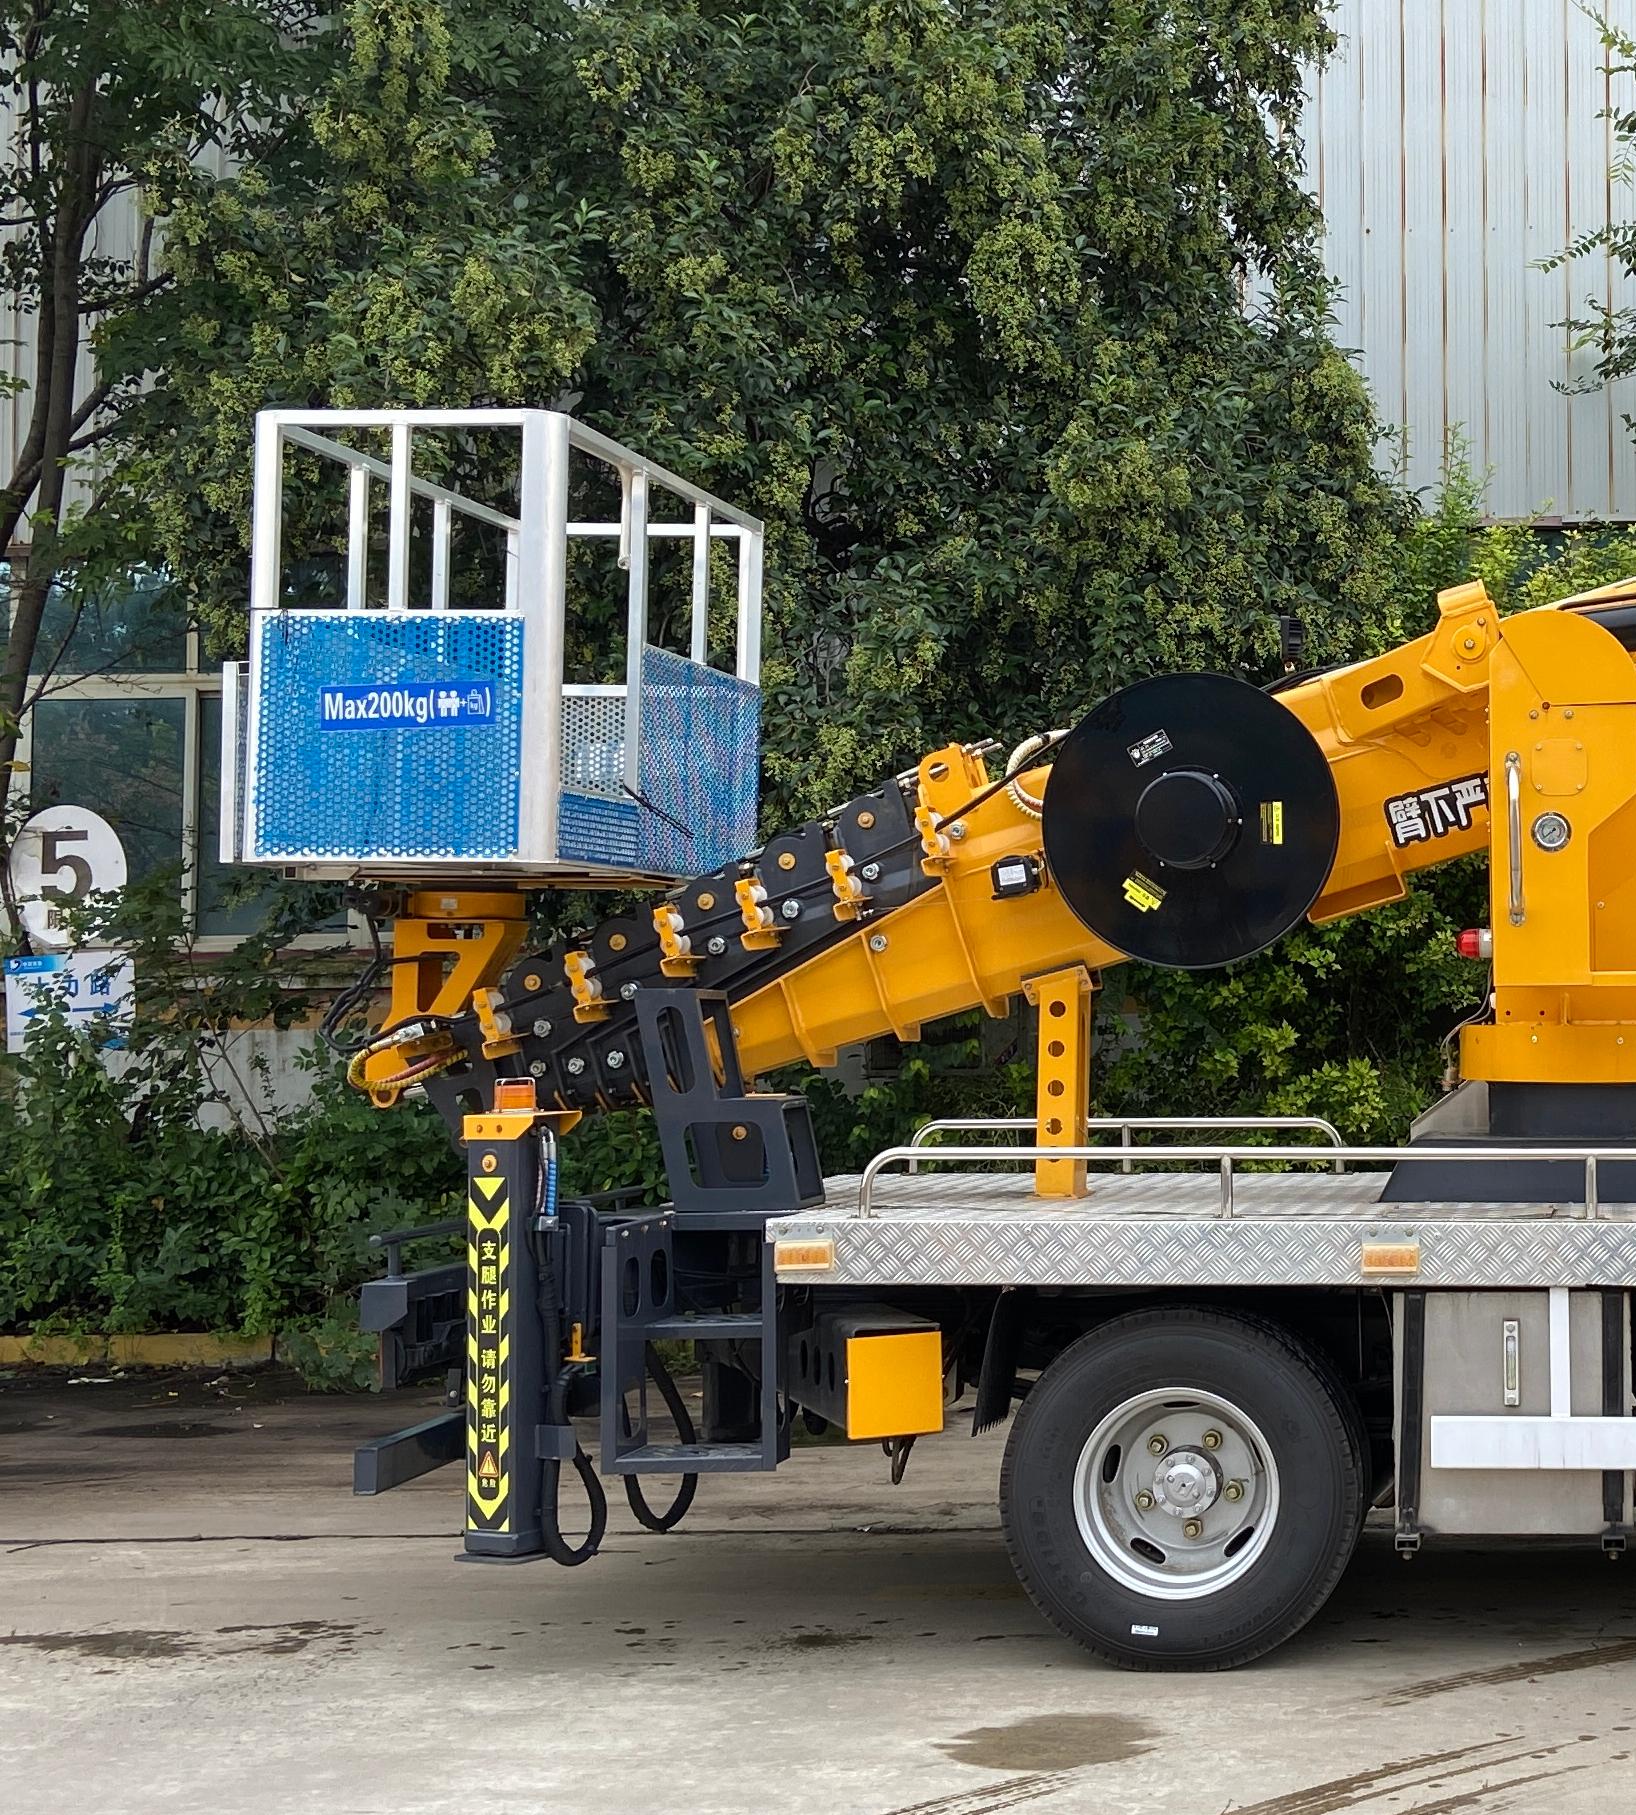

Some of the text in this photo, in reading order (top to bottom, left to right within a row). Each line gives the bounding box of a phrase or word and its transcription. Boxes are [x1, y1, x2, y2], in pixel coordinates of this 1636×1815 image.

[1388, 777, 1489, 845] 臂下严
[41, 830, 94, 901] 5
[480, 1239, 498, 1443] 支腿作业 请勿靠近
